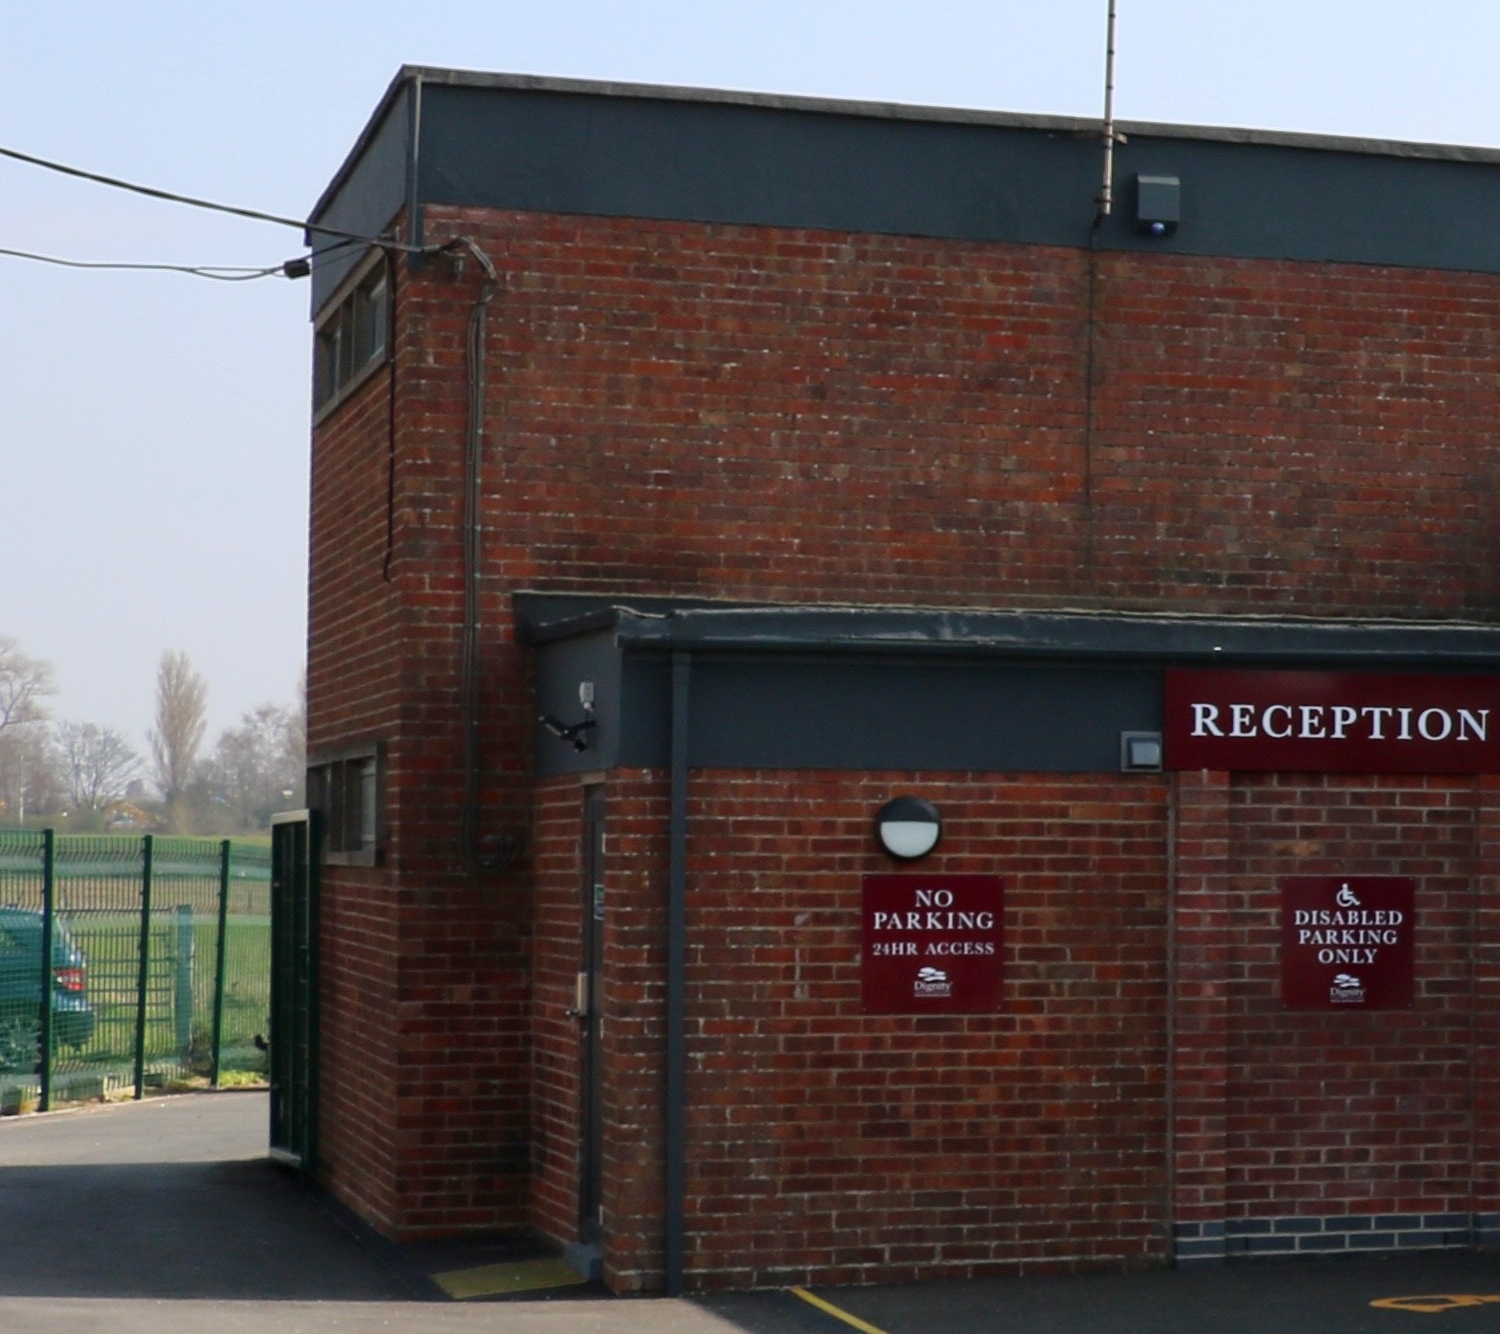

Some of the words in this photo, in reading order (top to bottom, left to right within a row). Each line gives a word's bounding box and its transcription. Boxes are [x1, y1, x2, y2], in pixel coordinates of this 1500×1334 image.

[1190, 703, 1491, 742] RECEPTION
[915, 889, 954, 907] NO
[873, 910, 995, 930] PARKING
[1294, 909, 1404, 926] DISABLED
[1298, 929, 1398, 946] PARKING
[872, 942, 918, 956] 24HR
[926, 942, 995, 955] ACCESS
[1318, 948, 1377, 964] ONLY
